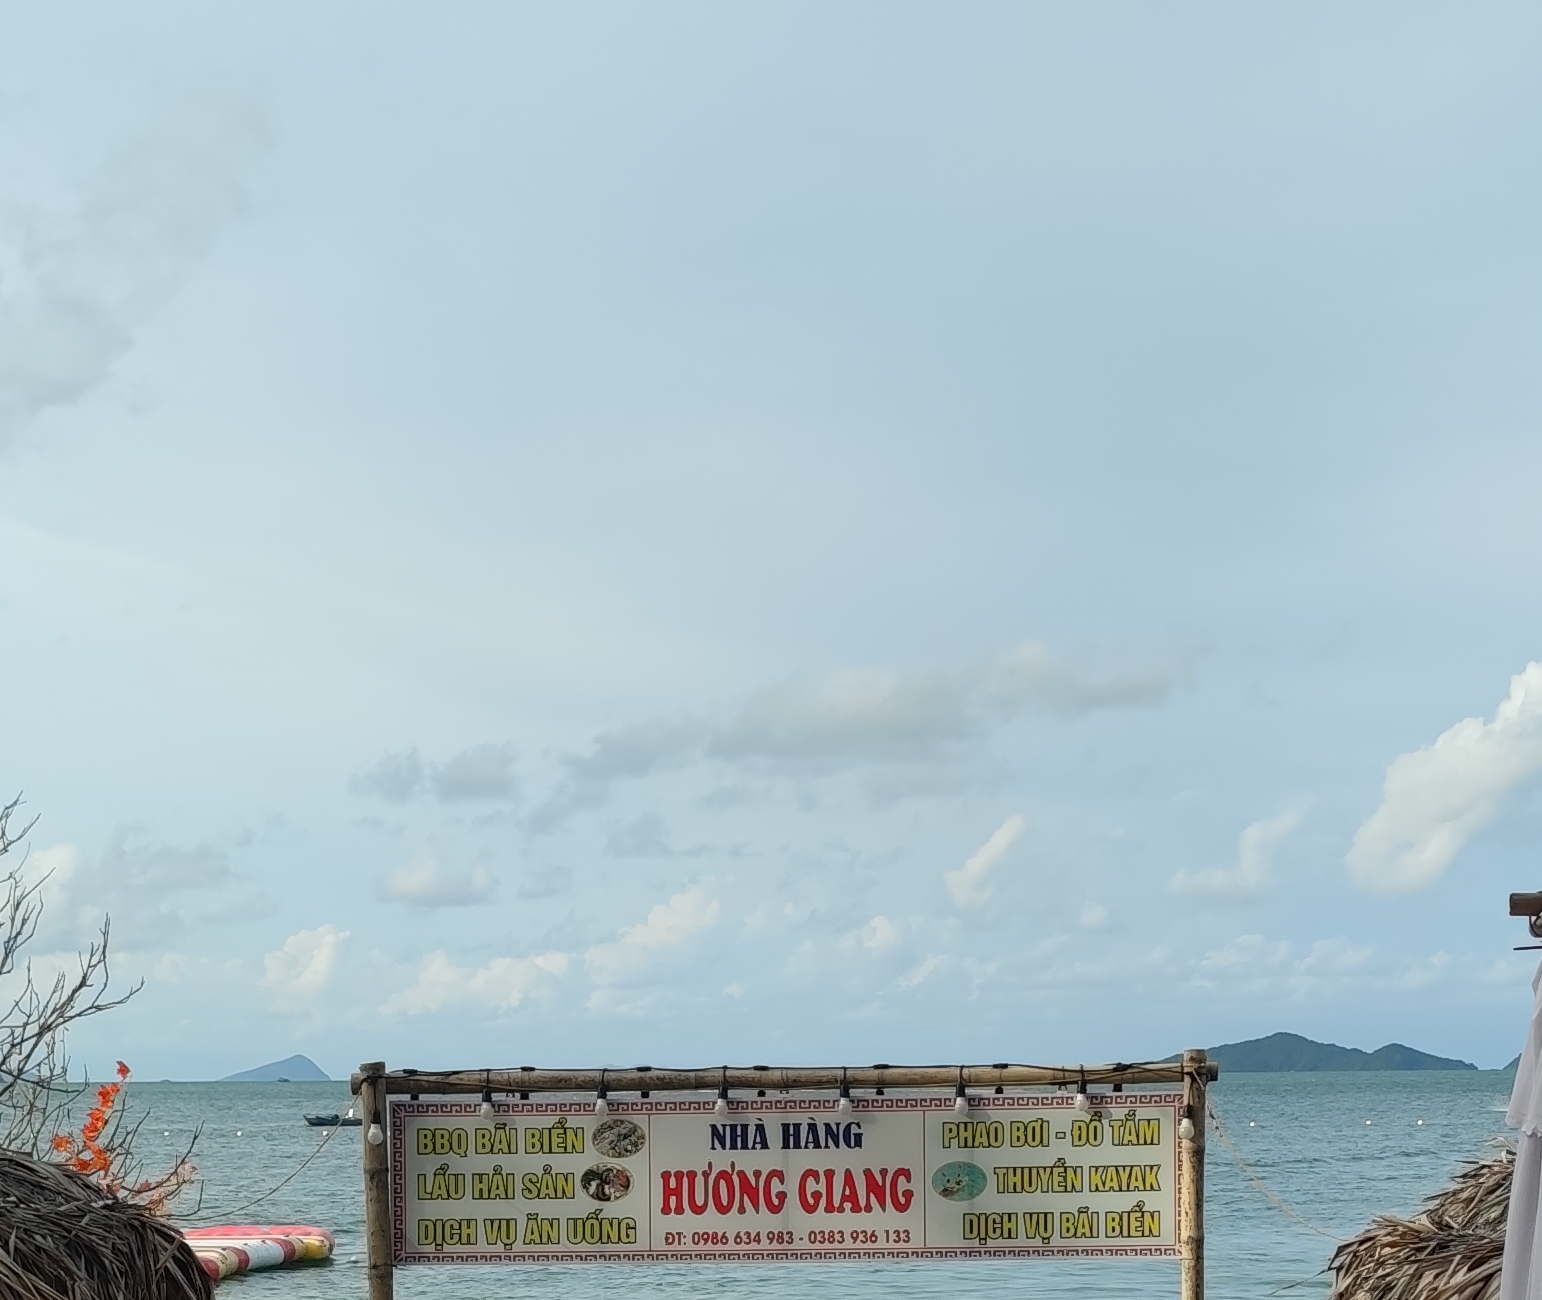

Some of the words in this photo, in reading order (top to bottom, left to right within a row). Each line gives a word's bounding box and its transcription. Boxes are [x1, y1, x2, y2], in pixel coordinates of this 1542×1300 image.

[417, 1128, 468, 1157] BBQ
[475, 1123, 518, 1154] BÃI
[524, 1117, 585, 1154] BIỂN
[709, 1118, 770, 1150] NHÀ
[781, 1117, 863, 1150] HÀNG
[942, 1121, 1004, 1148] PHAO
[1010, 1118, 1049, 1147] BƠI
[1071, 1111, 1104, 1147] ĐỒ
[1109, 1110, 1160, 1146] TẮM
[417, 1163, 465, 1200] LẨU
[472, 1165, 515, 1200] HẢI
[522, 1165, 575, 1199] SẢN
[660, 1159, 787, 1215] HƯƠNG
[798, 1167, 914, 1214] GIANG
[994, 1158, 1083, 1193] THUYỀN
[1089, 1164, 1161, 1192] KAYAK
[417, 1218, 477, 1251] DỊCH
[483, 1218, 517, 1250] VỤ
[523, 1213, 560, 1244] ĂN
[567, 1208, 637, 1244] UỐNG
[664, 1232, 687, 1246] ĐT:
[692, 1230, 729, 1245] 0986
[733, 1230, 761, 1245] 634
[766, 1230, 794, 1245] 983
[808, 1230, 846, 1245] 0383
[850, 1229, 878, 1244] 936
[883, 1229, 911, 1244] 133
[963, 1212, 1018, 1245] DỊCH
[1023, 1212, 1054, 1244] VỤ
[1060, 1206, 1099, 1238] BÃI
[1105, 1200, 1160, 1238] BIỂN
